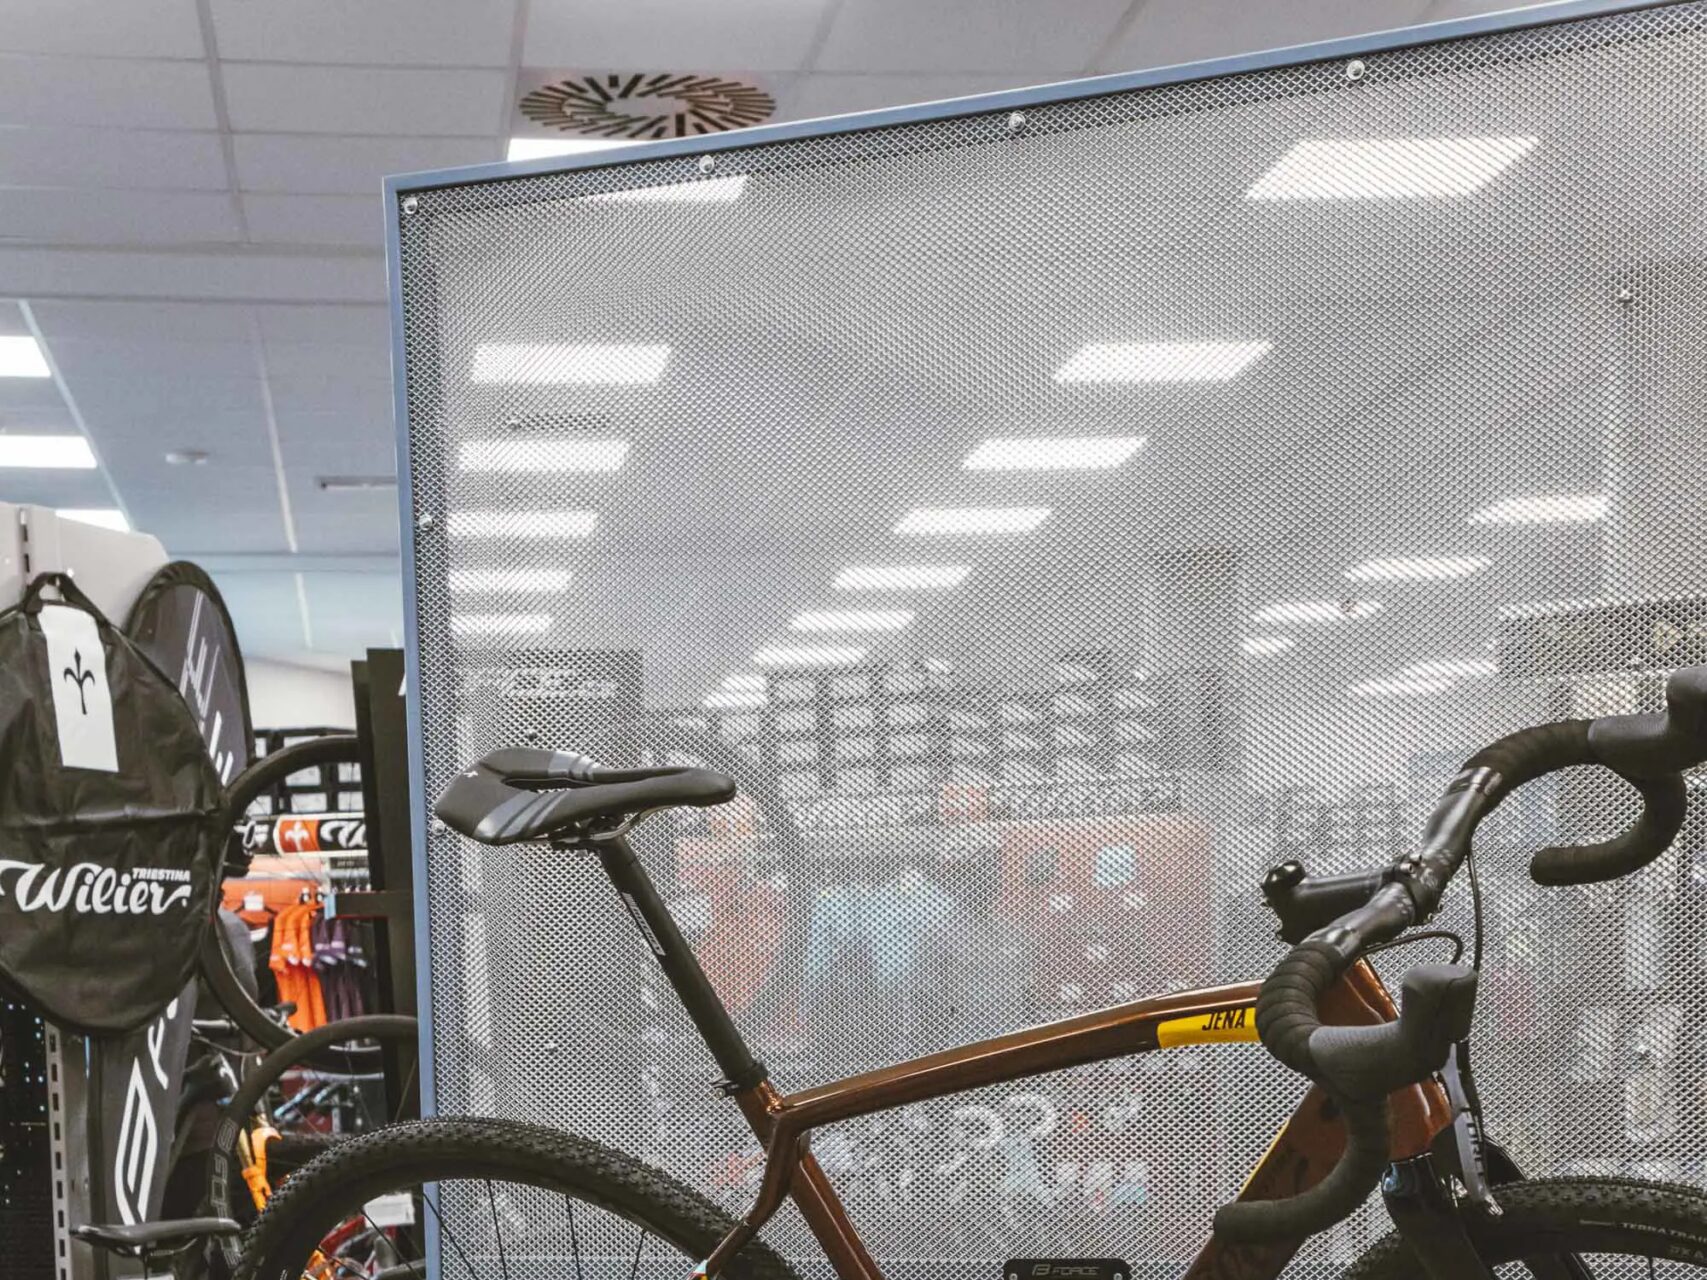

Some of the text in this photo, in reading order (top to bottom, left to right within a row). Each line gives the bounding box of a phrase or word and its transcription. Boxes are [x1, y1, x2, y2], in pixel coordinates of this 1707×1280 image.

[131, 867, 191, 882] TRIESTINA
[0, 860, 192, 915] Wilier
[1202, 1009, 1245, 1031] JENA
